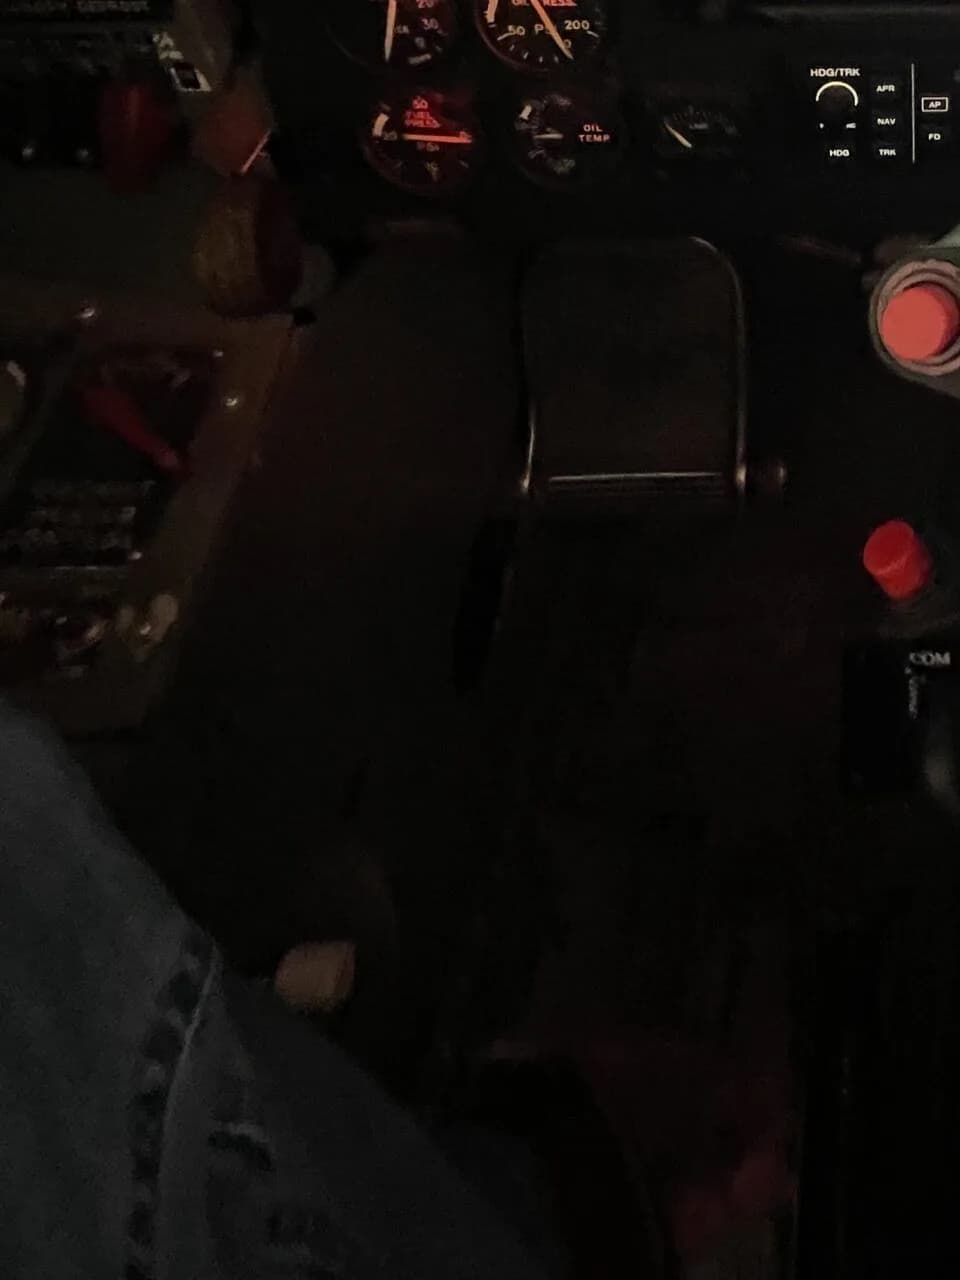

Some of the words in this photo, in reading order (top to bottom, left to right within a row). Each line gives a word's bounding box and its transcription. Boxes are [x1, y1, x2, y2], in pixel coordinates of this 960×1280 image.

[564, 19, 590, 31] 200
[508, 25, 526, 36] 50
[810, 68, 861, 78] HDG/TRK
[876, 84, 895, 92] APR
[928, 101, 942, 109] AP
[877, 118, 896, 126] NAV
[583, 124, 602, 132] OIL
[578, 134, 610, 142] TEMP
[928, 133, 941, 141] FD
[829, 149, 850, 157] HDG
[879, 148, 896, 156] TRK
[909, 650, 951, 665] COM
